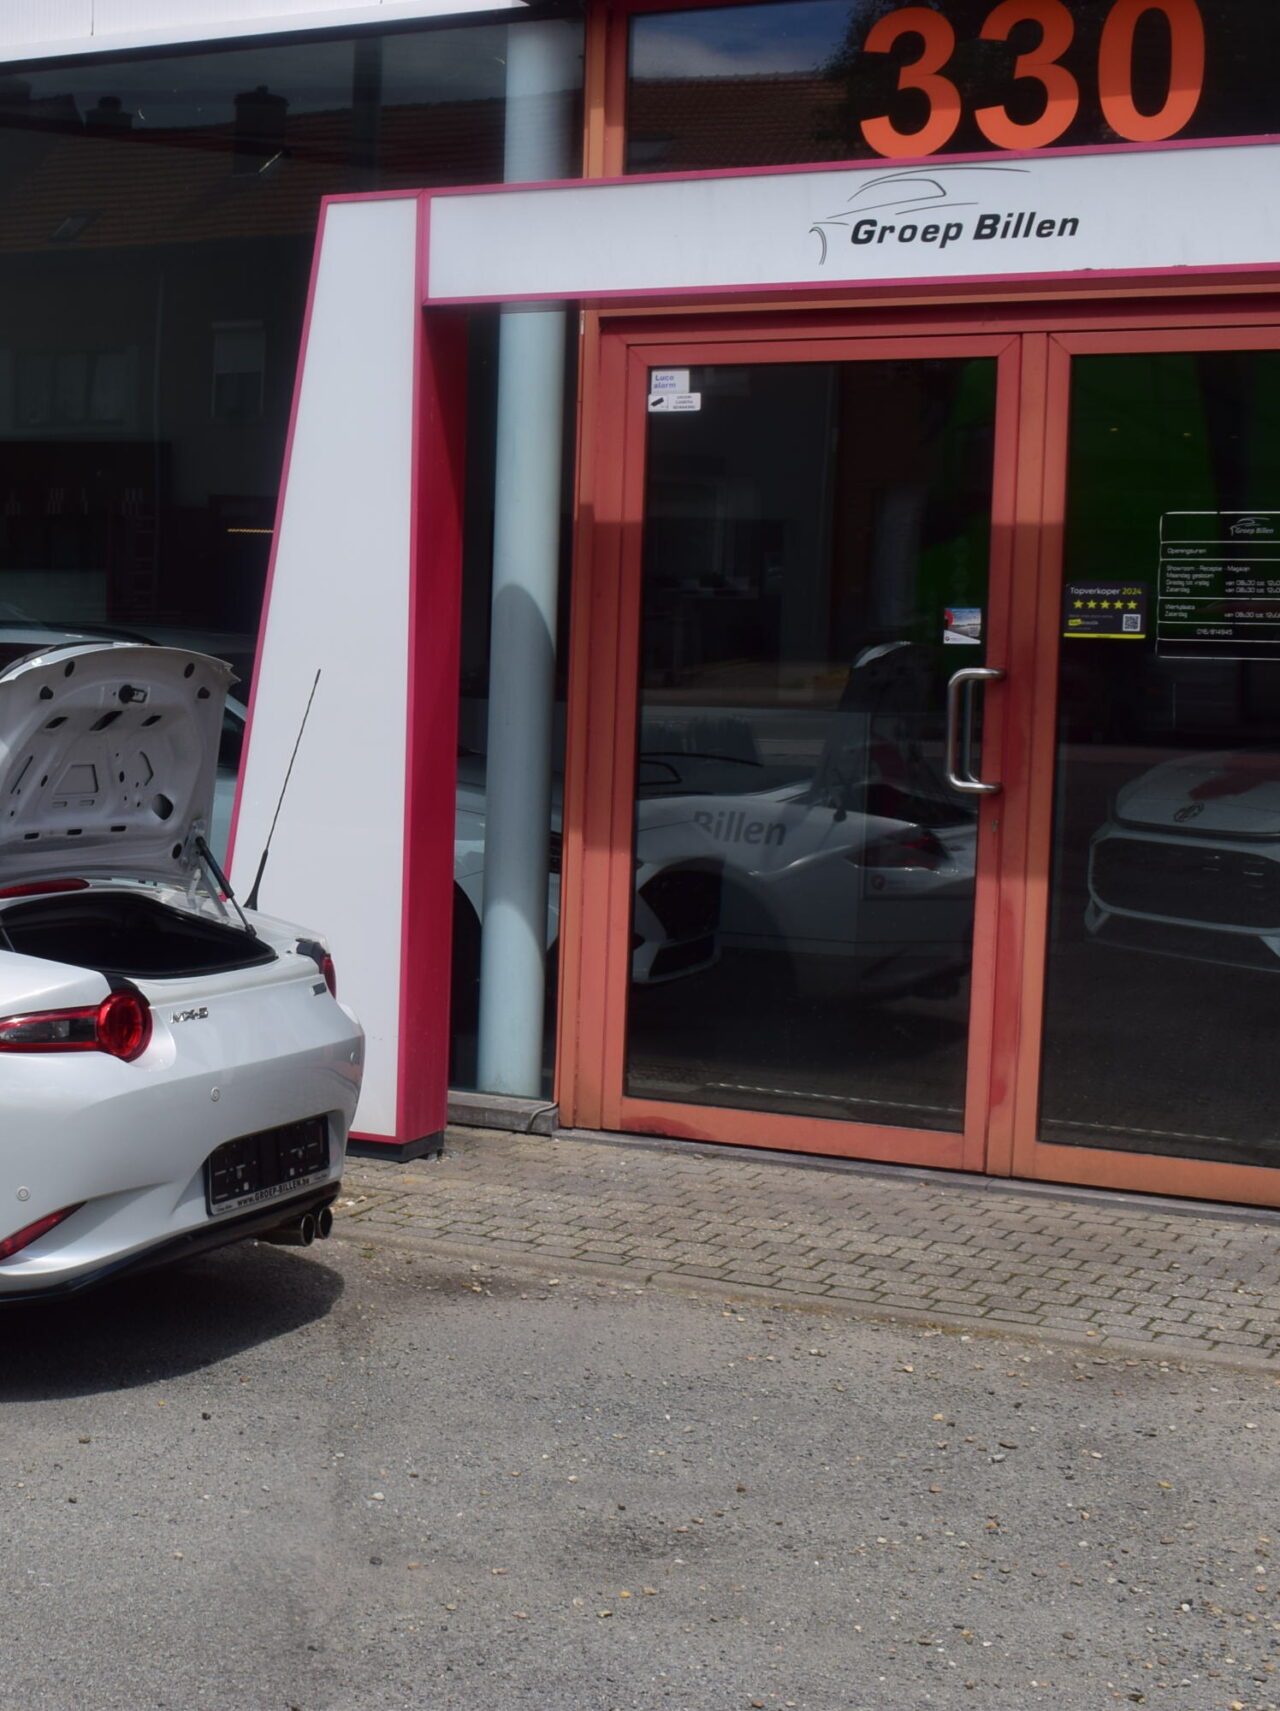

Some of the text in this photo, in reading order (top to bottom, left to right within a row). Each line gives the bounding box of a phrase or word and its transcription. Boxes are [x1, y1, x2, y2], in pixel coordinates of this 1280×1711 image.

[859, 0, 1206, 159] 330
[850, 211, 1080, 249] Groep Billen
[1070, 587, 1121, 596] Topverkoper
[169, 1006, 209, 1024] MX-5
